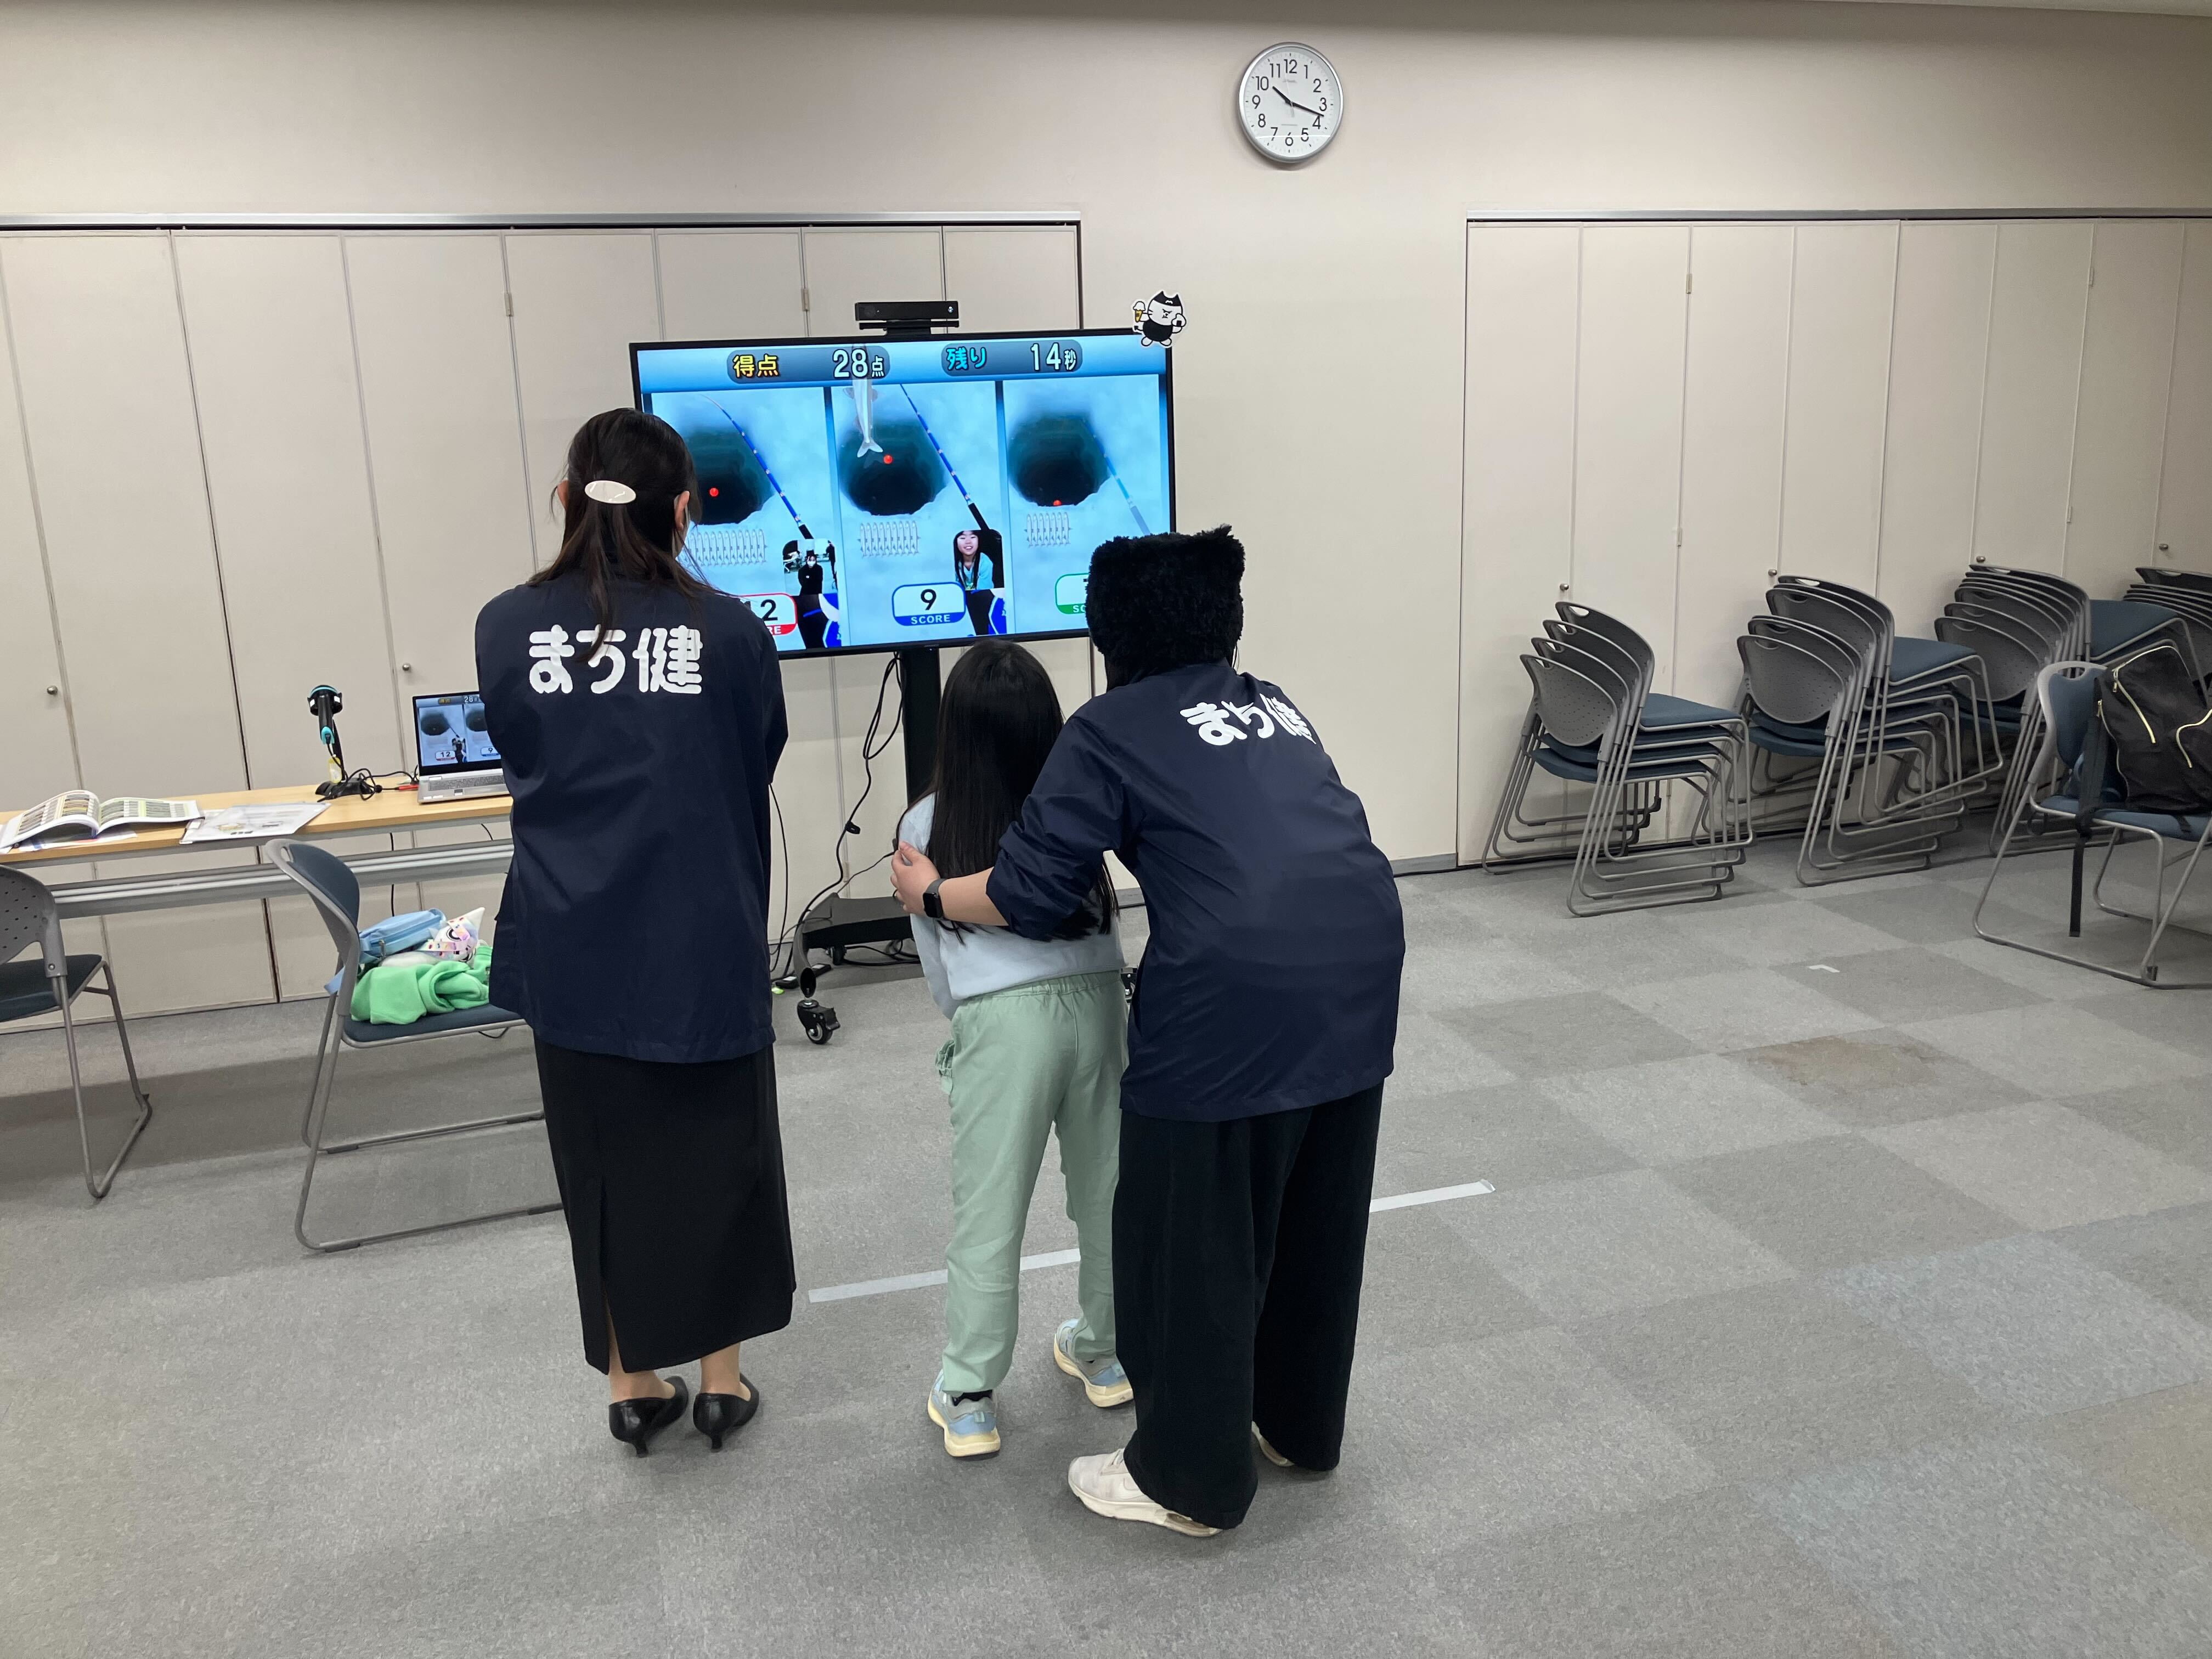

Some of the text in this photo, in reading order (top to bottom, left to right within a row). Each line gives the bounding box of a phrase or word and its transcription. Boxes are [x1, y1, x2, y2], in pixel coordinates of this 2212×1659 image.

[1269, 63, 1280, 78] 11
[1284, 59, 1297, 74] 12
[1304, 65, 1308, 79] 1
[1256, 76, 1269, 91] 10
[1313, 78, 1321, 92] 2
[1252, 95, 1261, 109] 9
[1319, 97, 1327, 111] 3
[1258, 114, 1266, 127] 8
[1312, 114, 1321, 129] 4
[1271, 127, 1278, 141] 7
[1285, 132, 1294, 146] 6
[1301, 128, 1309, 142] 5
[732, 348, 885, 378] 得点 28点
[946, 342, 1076, 371] 残り 14秒
[921, 589, 936, 610] 9
[911, 614, 951, 625] SCORE
[529, 624, 703, 693] まち健
